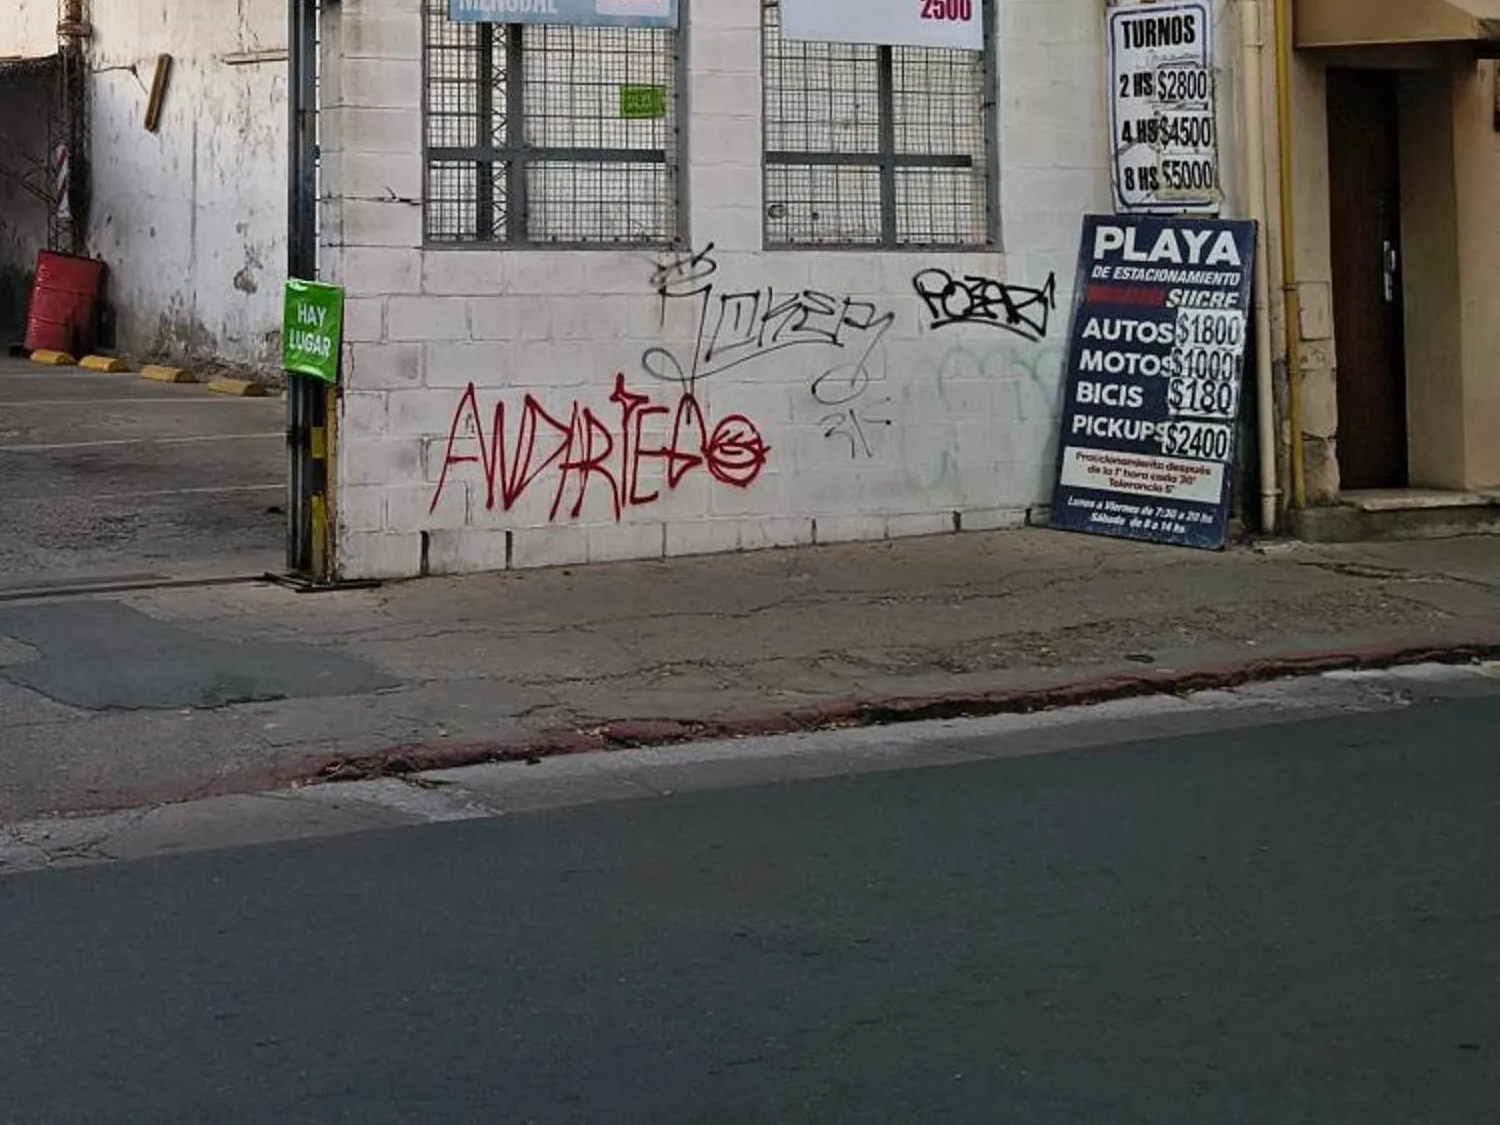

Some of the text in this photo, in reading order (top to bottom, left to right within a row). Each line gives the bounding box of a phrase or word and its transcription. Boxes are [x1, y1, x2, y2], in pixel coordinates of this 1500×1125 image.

[1121, 15, 1195, 49] TURNOS
[1120, 71, 1207, 100] 2 HS $2800
[1121, 115, 1211, 148] 4 HS $4500
[1124, 167, 1134, 191] 8
[1139, 167, 1159, 191] HS
[1093, 226, 1241, 266] PLAYA
[1092, 266, 1241, 286] DE ESTACIONAMIENTO
[1165, 288, 1239, 308] SUCRE
[297, 302, 327, 328] HAY
[1082, 312, 1243, 346] AUTOS $1800
[289, 328, 332, 358] LUGAR
[1079, 347, 1235, 382] MOTOS $1000
[1075, 378, 1233, 414] BICIS $180
[1072, 414, 1229, 459] PICKUPS $2400
[1076, 451, 1164, 470] Fraccionamiento
[1088, 465, 1100, 474] de
[1103, 466, 1113, 476] la
[1124, 468, 1149, 479] hora
[1151, 473, 1177, 483] cada
[1109, 478, 1162, 492] Tolerancia
[1067, 495, 1095, 508] Lunes
[1104, 500, 1140, 514] Viernes
[1141, 505, 1154, 516] de
